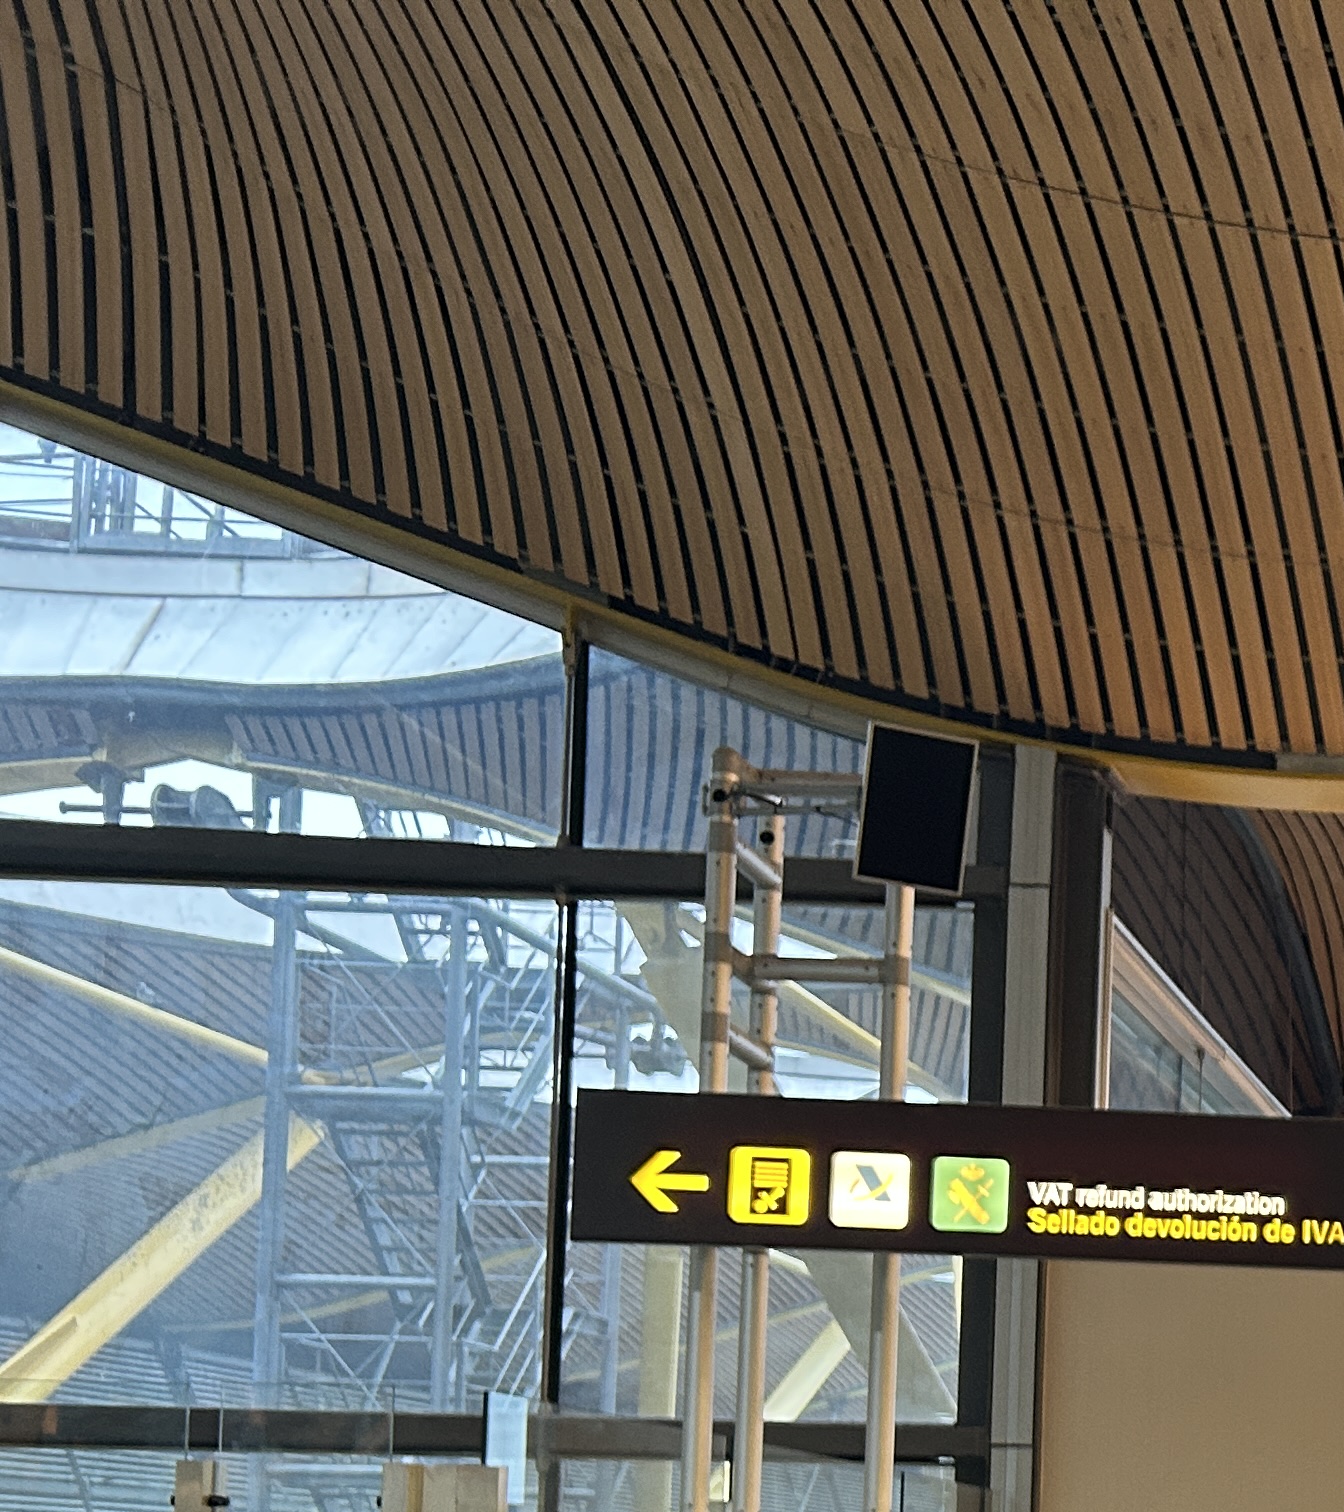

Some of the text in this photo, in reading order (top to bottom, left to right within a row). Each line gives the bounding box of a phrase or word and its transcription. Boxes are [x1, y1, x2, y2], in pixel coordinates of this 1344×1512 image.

[1027, 1181, 1286, 1216] VAT refund authorization
[1027, 1207, 1121, 1236] Sellado
[1125, 1212, 1258, 1243] devolución
[1263, 1218, 1295, 1245] de
